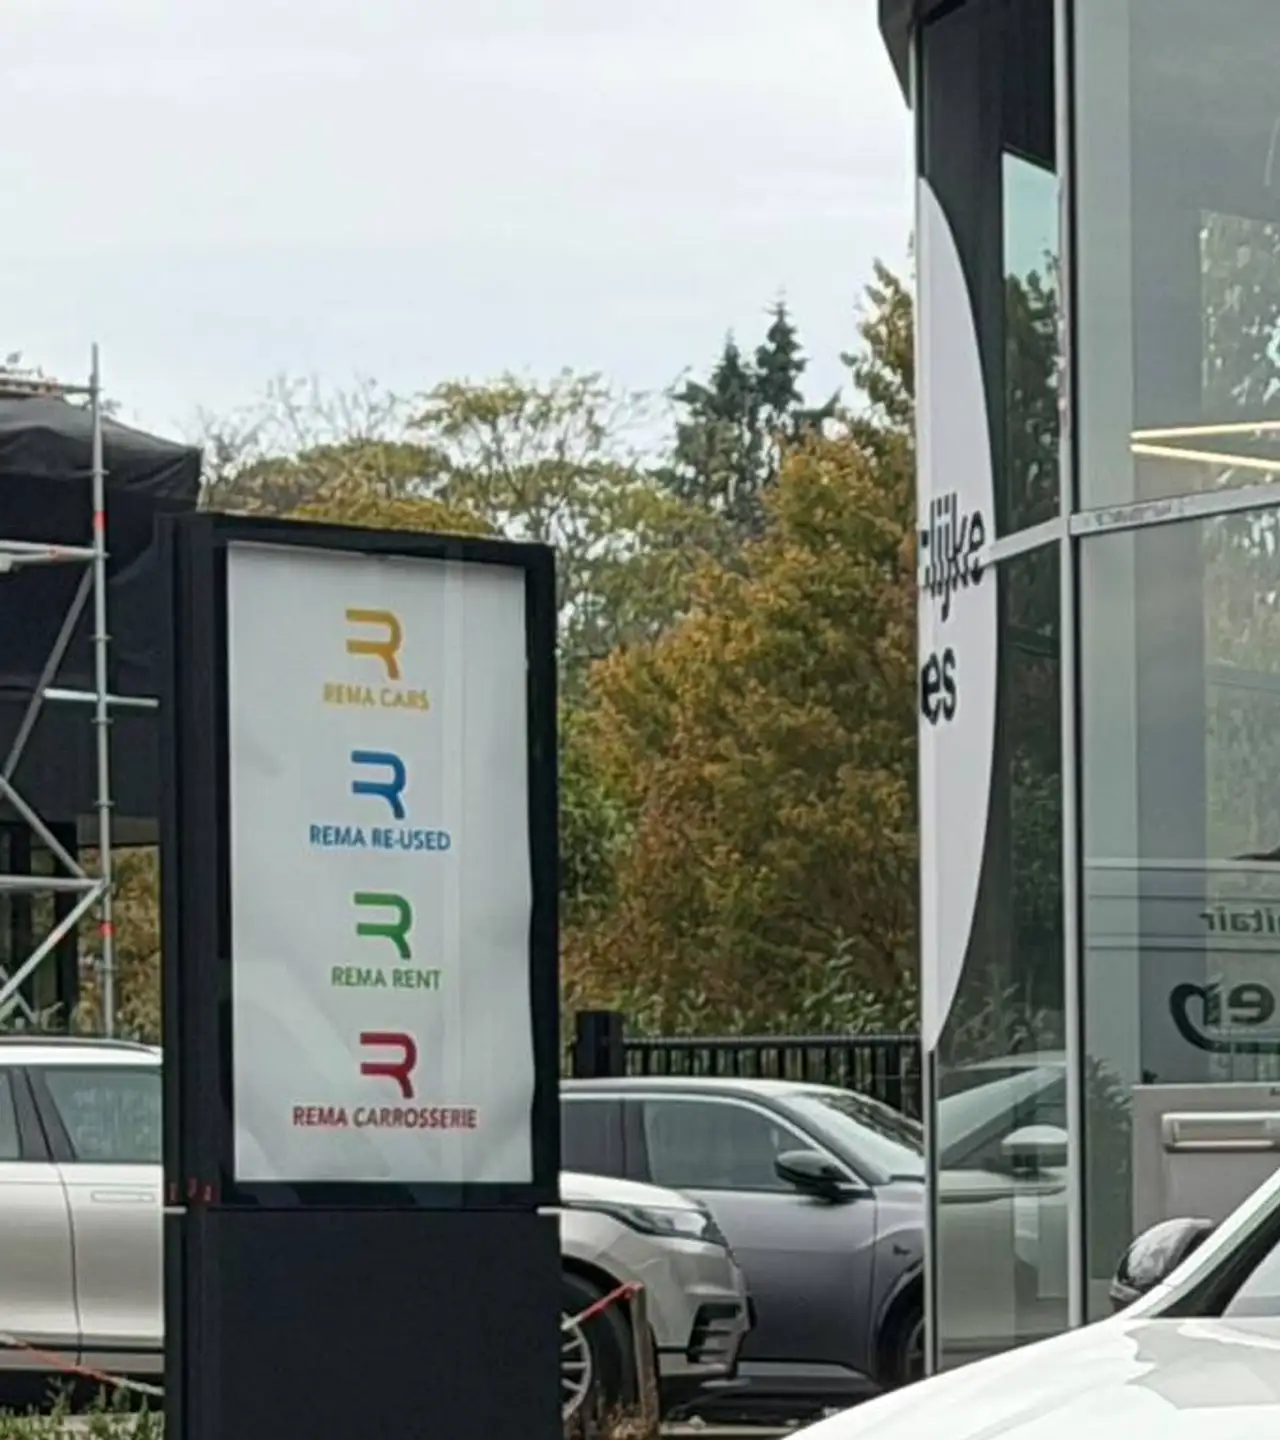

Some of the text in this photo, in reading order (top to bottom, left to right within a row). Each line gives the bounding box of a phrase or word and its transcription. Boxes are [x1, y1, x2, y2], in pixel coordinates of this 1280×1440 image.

[322, 682, 430, 710] REMA CARS
[309, 825, 451, 852] REMA RE-USED
[331, 966, 441, 991] REMA RENT
[292, 1104, 477, 1130] REMA CARROSSERIE
